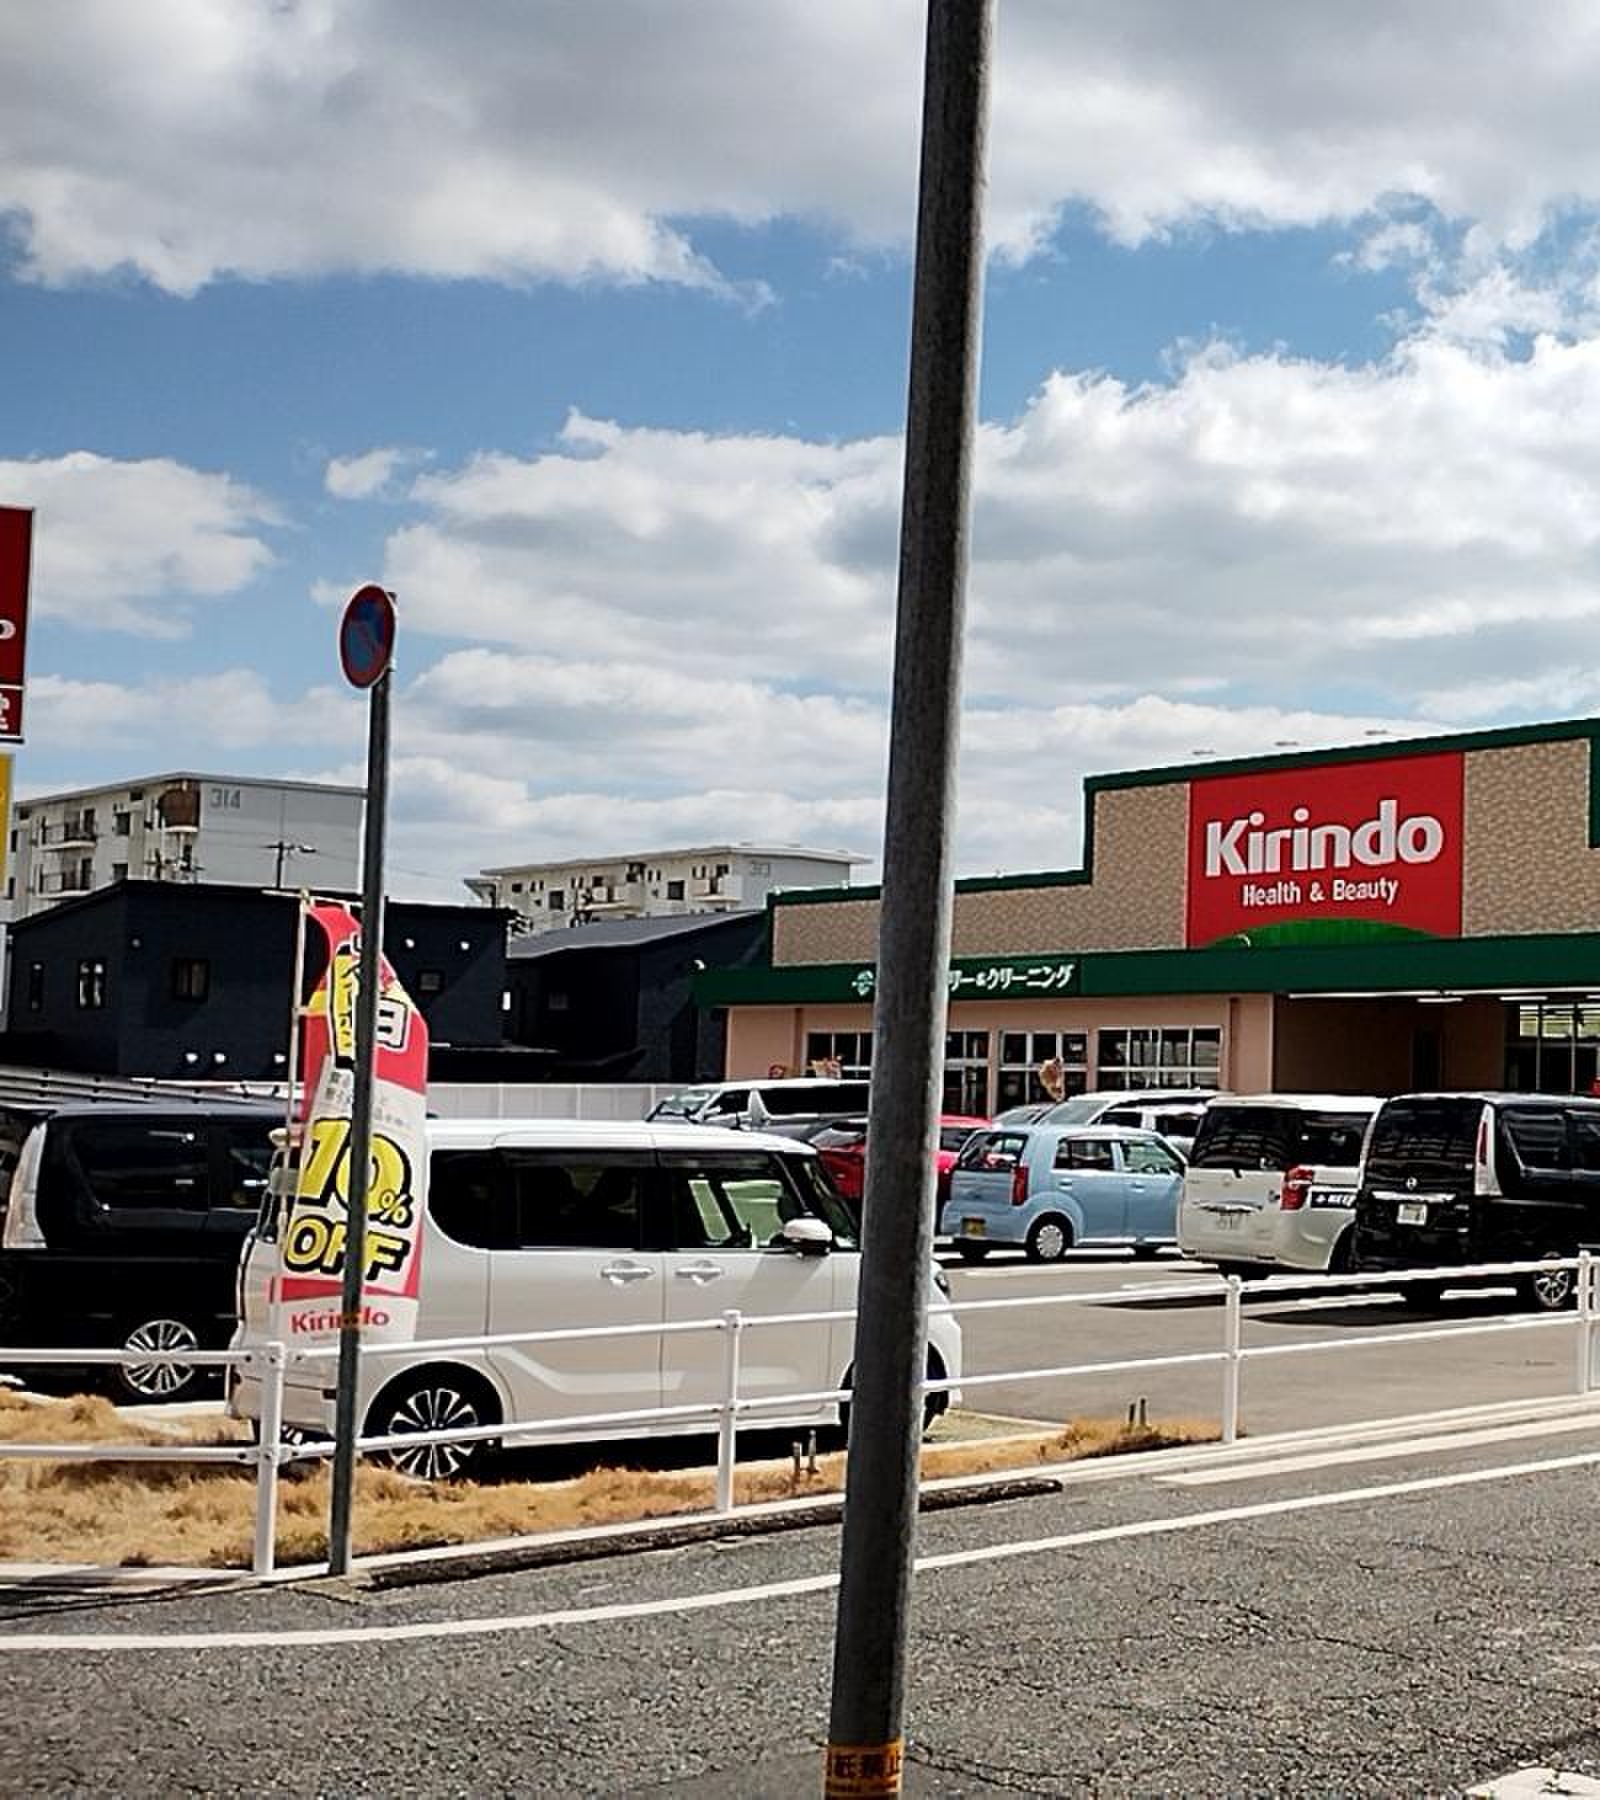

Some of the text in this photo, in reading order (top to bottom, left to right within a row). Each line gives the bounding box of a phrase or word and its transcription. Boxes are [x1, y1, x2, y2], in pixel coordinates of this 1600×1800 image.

[1205, 799, 1444, 877] Kirindo
[1243, 877, 1399, 906] Health & Beauty
[291, 1306, 390, 1334] Kirido
